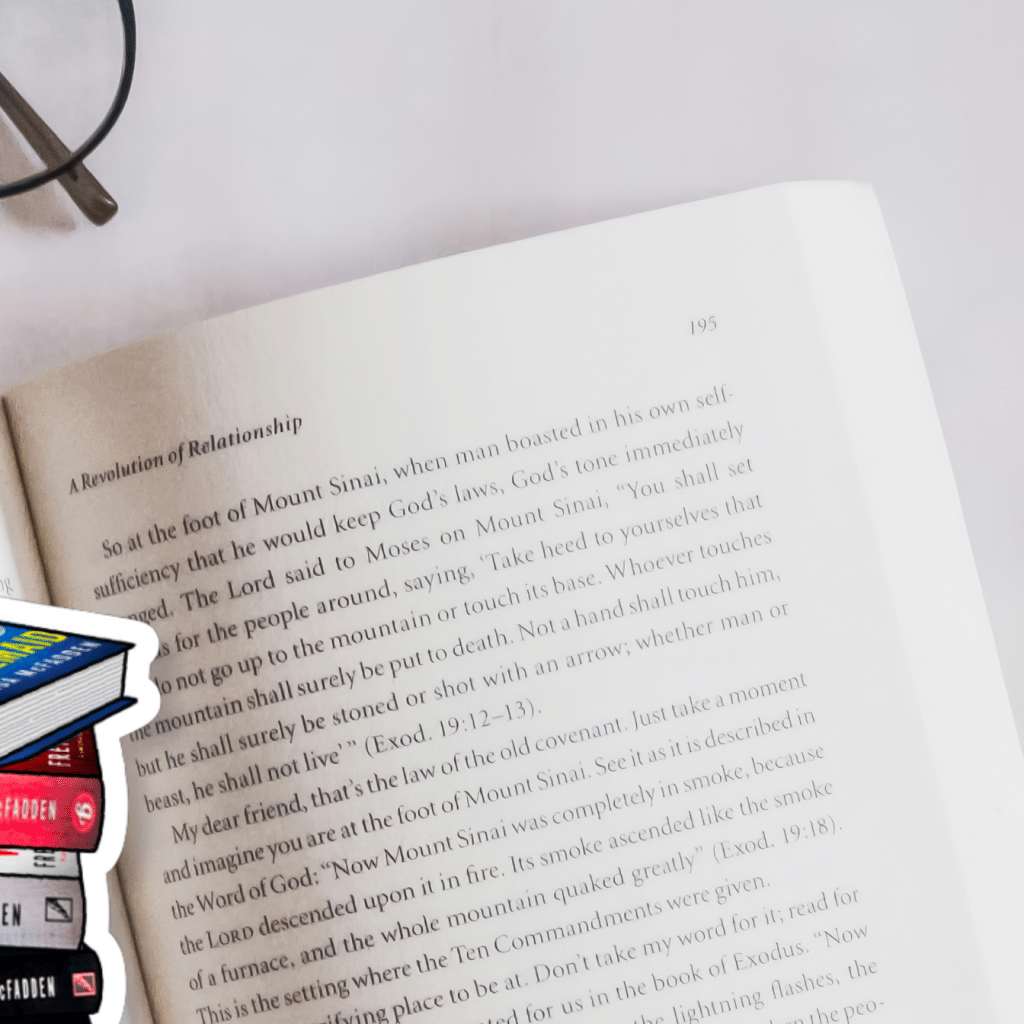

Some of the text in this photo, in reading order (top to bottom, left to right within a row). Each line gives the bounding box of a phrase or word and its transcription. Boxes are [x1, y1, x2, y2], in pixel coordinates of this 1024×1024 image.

[690, 316, 718, 336] 195
[70, 414, 302, 495] A Revolution of Relationship
[102, 539, 123, 559] So
[125, 532, 143, 552] at
[147, 523, 177, 545] the
[182, 511, 221, 536] foot
[227, 499, 246, 522] of
[251, 485, 323, 516] Mount
[329, 467, 387, 495] Sinai,
[393, 457, 448, 479] when
[455, 444, 499, 464] man
[505, 418, 582, 452] boasted
[589, 415, 607, 433] in
[614, 409, 643, 427] his
[650, 400, 689, 418] own
[234, 999, 249, 1018] is
[251, 993, 281, 1014] the
[284, 979, 350, 1006] setting
[351, 964, 411, 989] where
[416, 954, 447, 973] the
[451, 945, 489, 963] Ten
[494, 903, 662, 953] Commandments
[667, 890, 709, 910] were
[715, 877, 771, 905] given.
